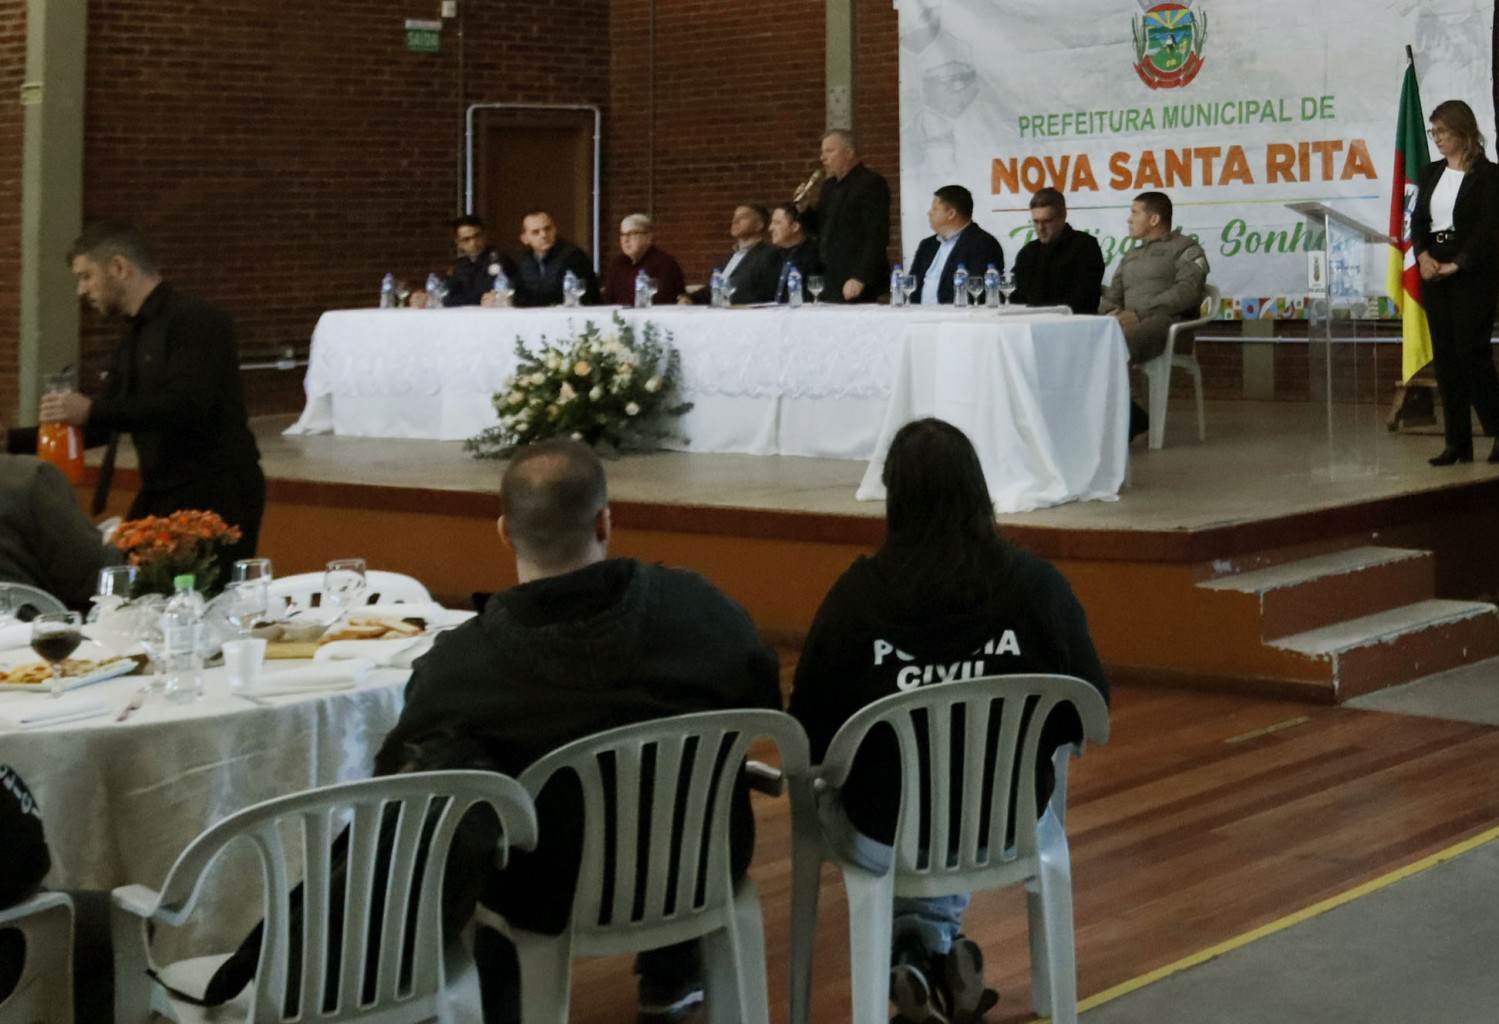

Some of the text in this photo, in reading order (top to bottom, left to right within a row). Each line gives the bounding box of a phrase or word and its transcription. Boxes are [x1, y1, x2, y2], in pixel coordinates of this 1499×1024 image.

[1018, 95, 1336, 137] PREFEITURA MUNICIPAL DE
[991, 138, 1378, 195] NOVA SANTA RITA
